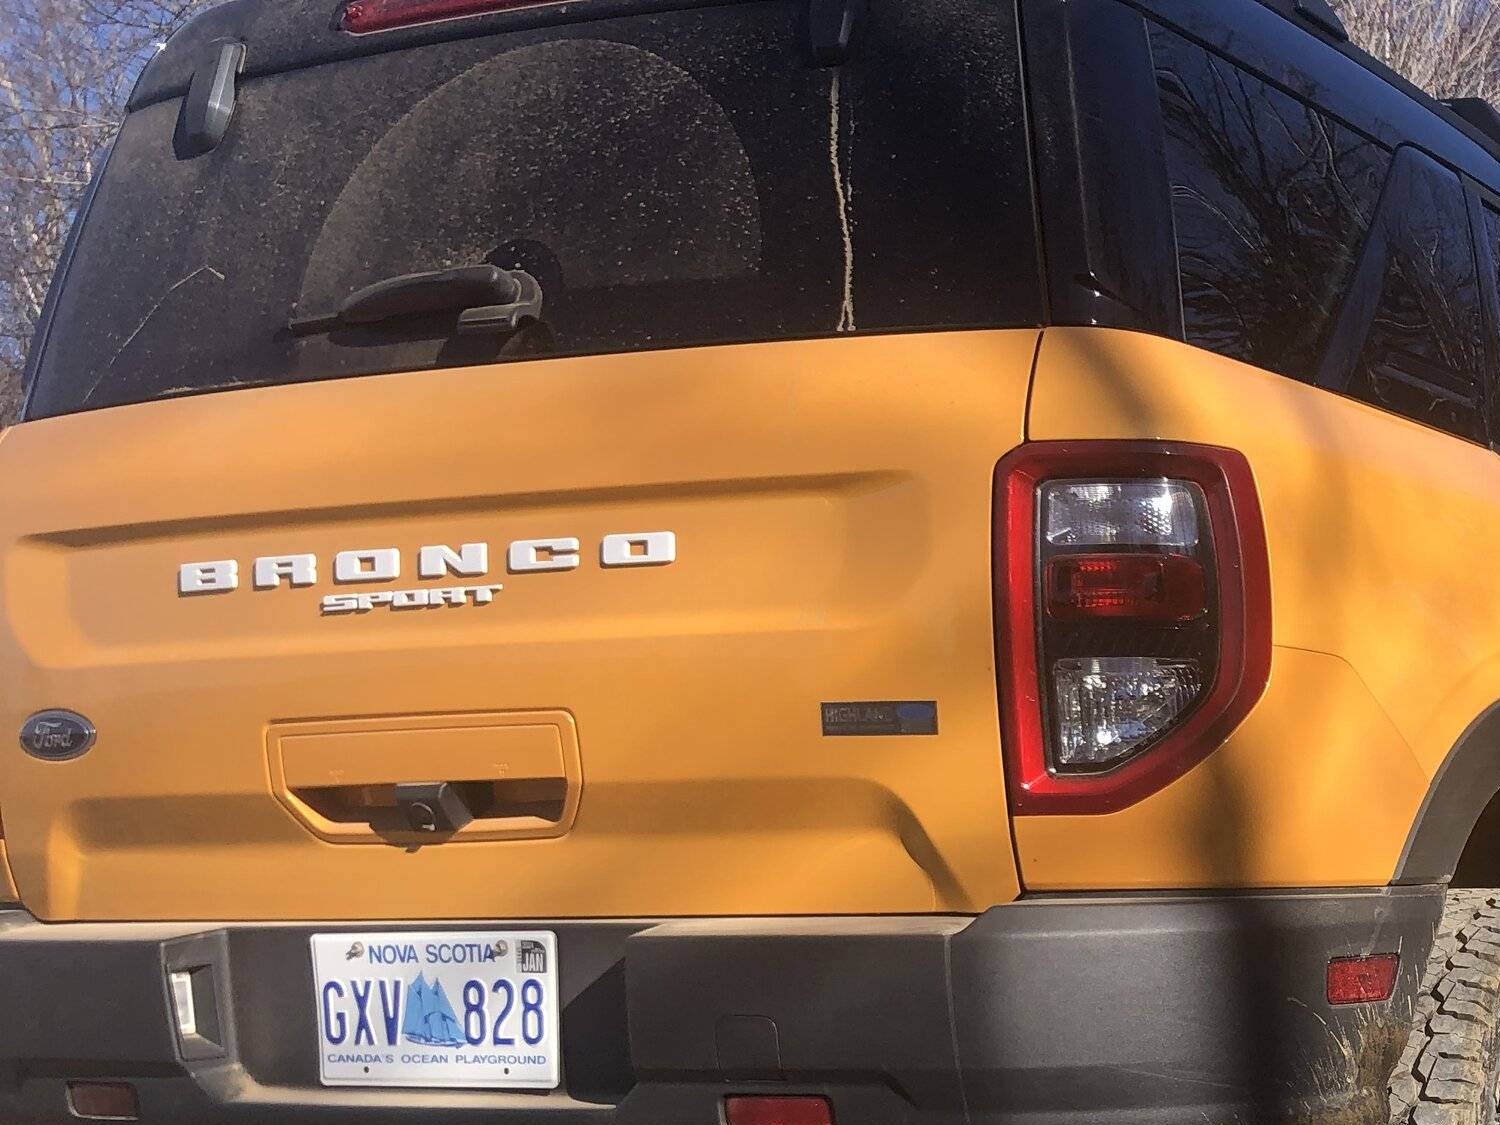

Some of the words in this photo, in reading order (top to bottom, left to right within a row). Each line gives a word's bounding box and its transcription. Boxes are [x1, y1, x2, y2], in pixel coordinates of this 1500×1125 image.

[179, 530, 677, 593] BRONCO
[322, 583, 503, 614] SPORT
[368, 942, 419, 965] NOVA
[426, 942, 496, 965] SCOTIA
[522, 952, 544, 972] JAN
[322, 979, 401, 1046] GXV
[463, 978, 545, 1046] 828
[327, 1053, 394, 1065] CANADA'S
[401, 1053, 449, 1065] OCEAN
[455, 1054, 547, 1066] PLAYGROUND
